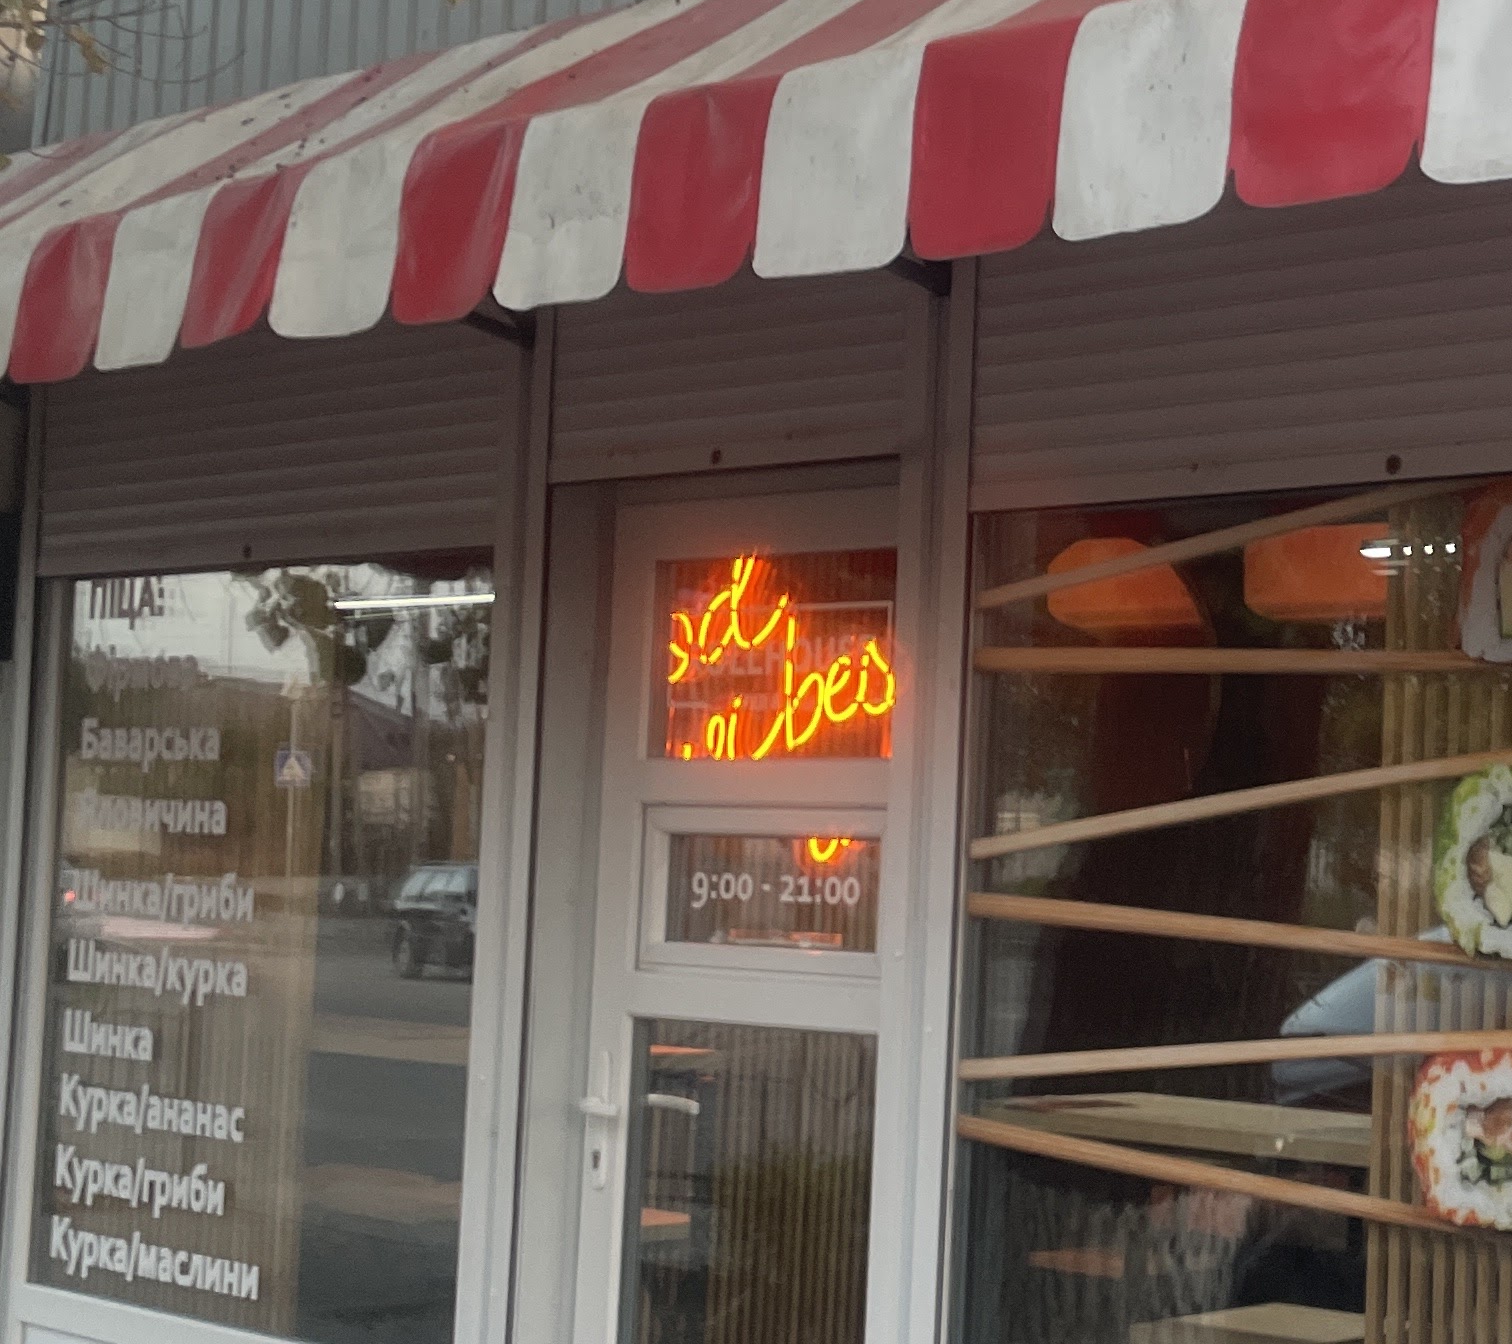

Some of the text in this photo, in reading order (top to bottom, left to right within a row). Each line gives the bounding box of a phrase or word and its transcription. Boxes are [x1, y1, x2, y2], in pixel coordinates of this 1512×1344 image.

[80, 717, 222, 772] Баварська
[73, 870, 255, 924] Шинка/гриби
[691, 872, 753, 908] 9:00
[779, 874, 861, 906] 21:00
[67, 939, 249, 1006] Шинка/курка
[63, 1008, 154, 1061] Шинка
[60, 1072, 246, 1143] Курка/ананас
[55, 1143, 226, 1217] Курка/гриби
[50, 1214, 260, 1301] Курка/маслини
